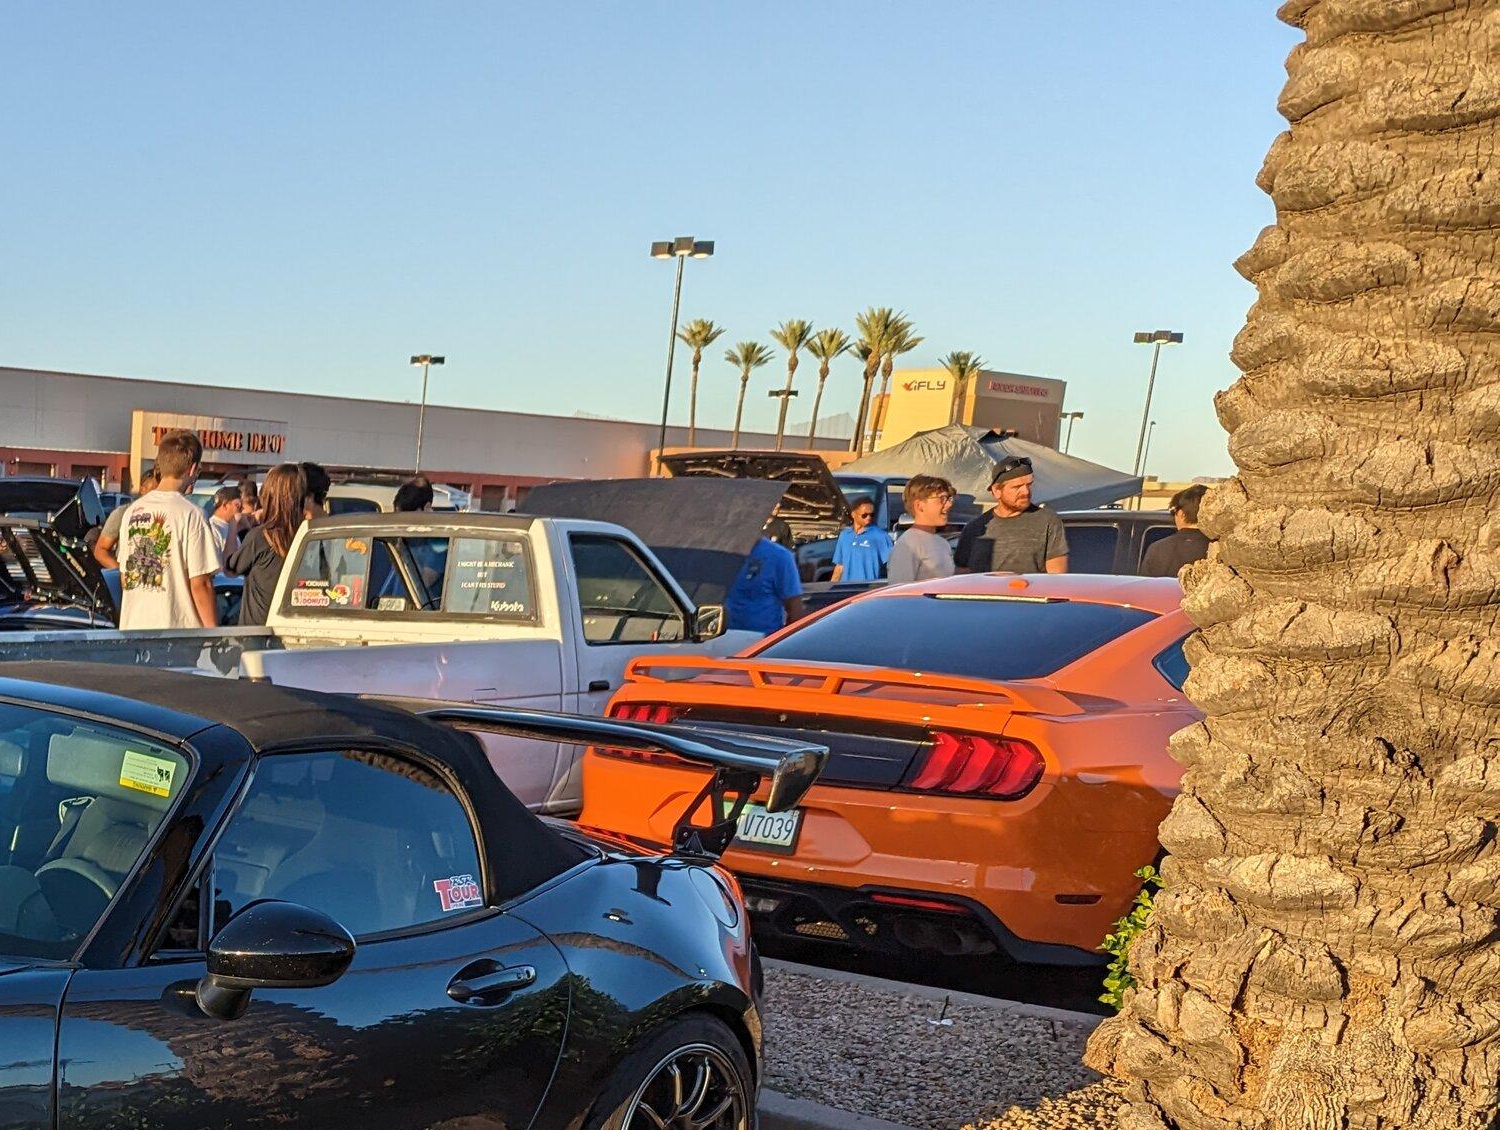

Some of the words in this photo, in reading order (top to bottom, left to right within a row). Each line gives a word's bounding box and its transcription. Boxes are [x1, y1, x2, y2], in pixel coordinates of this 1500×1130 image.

[198, 430, 244, 452] HOME
[247, 433, 287, 454] DEPOT
[490, 600, 525, 612] Kubota
